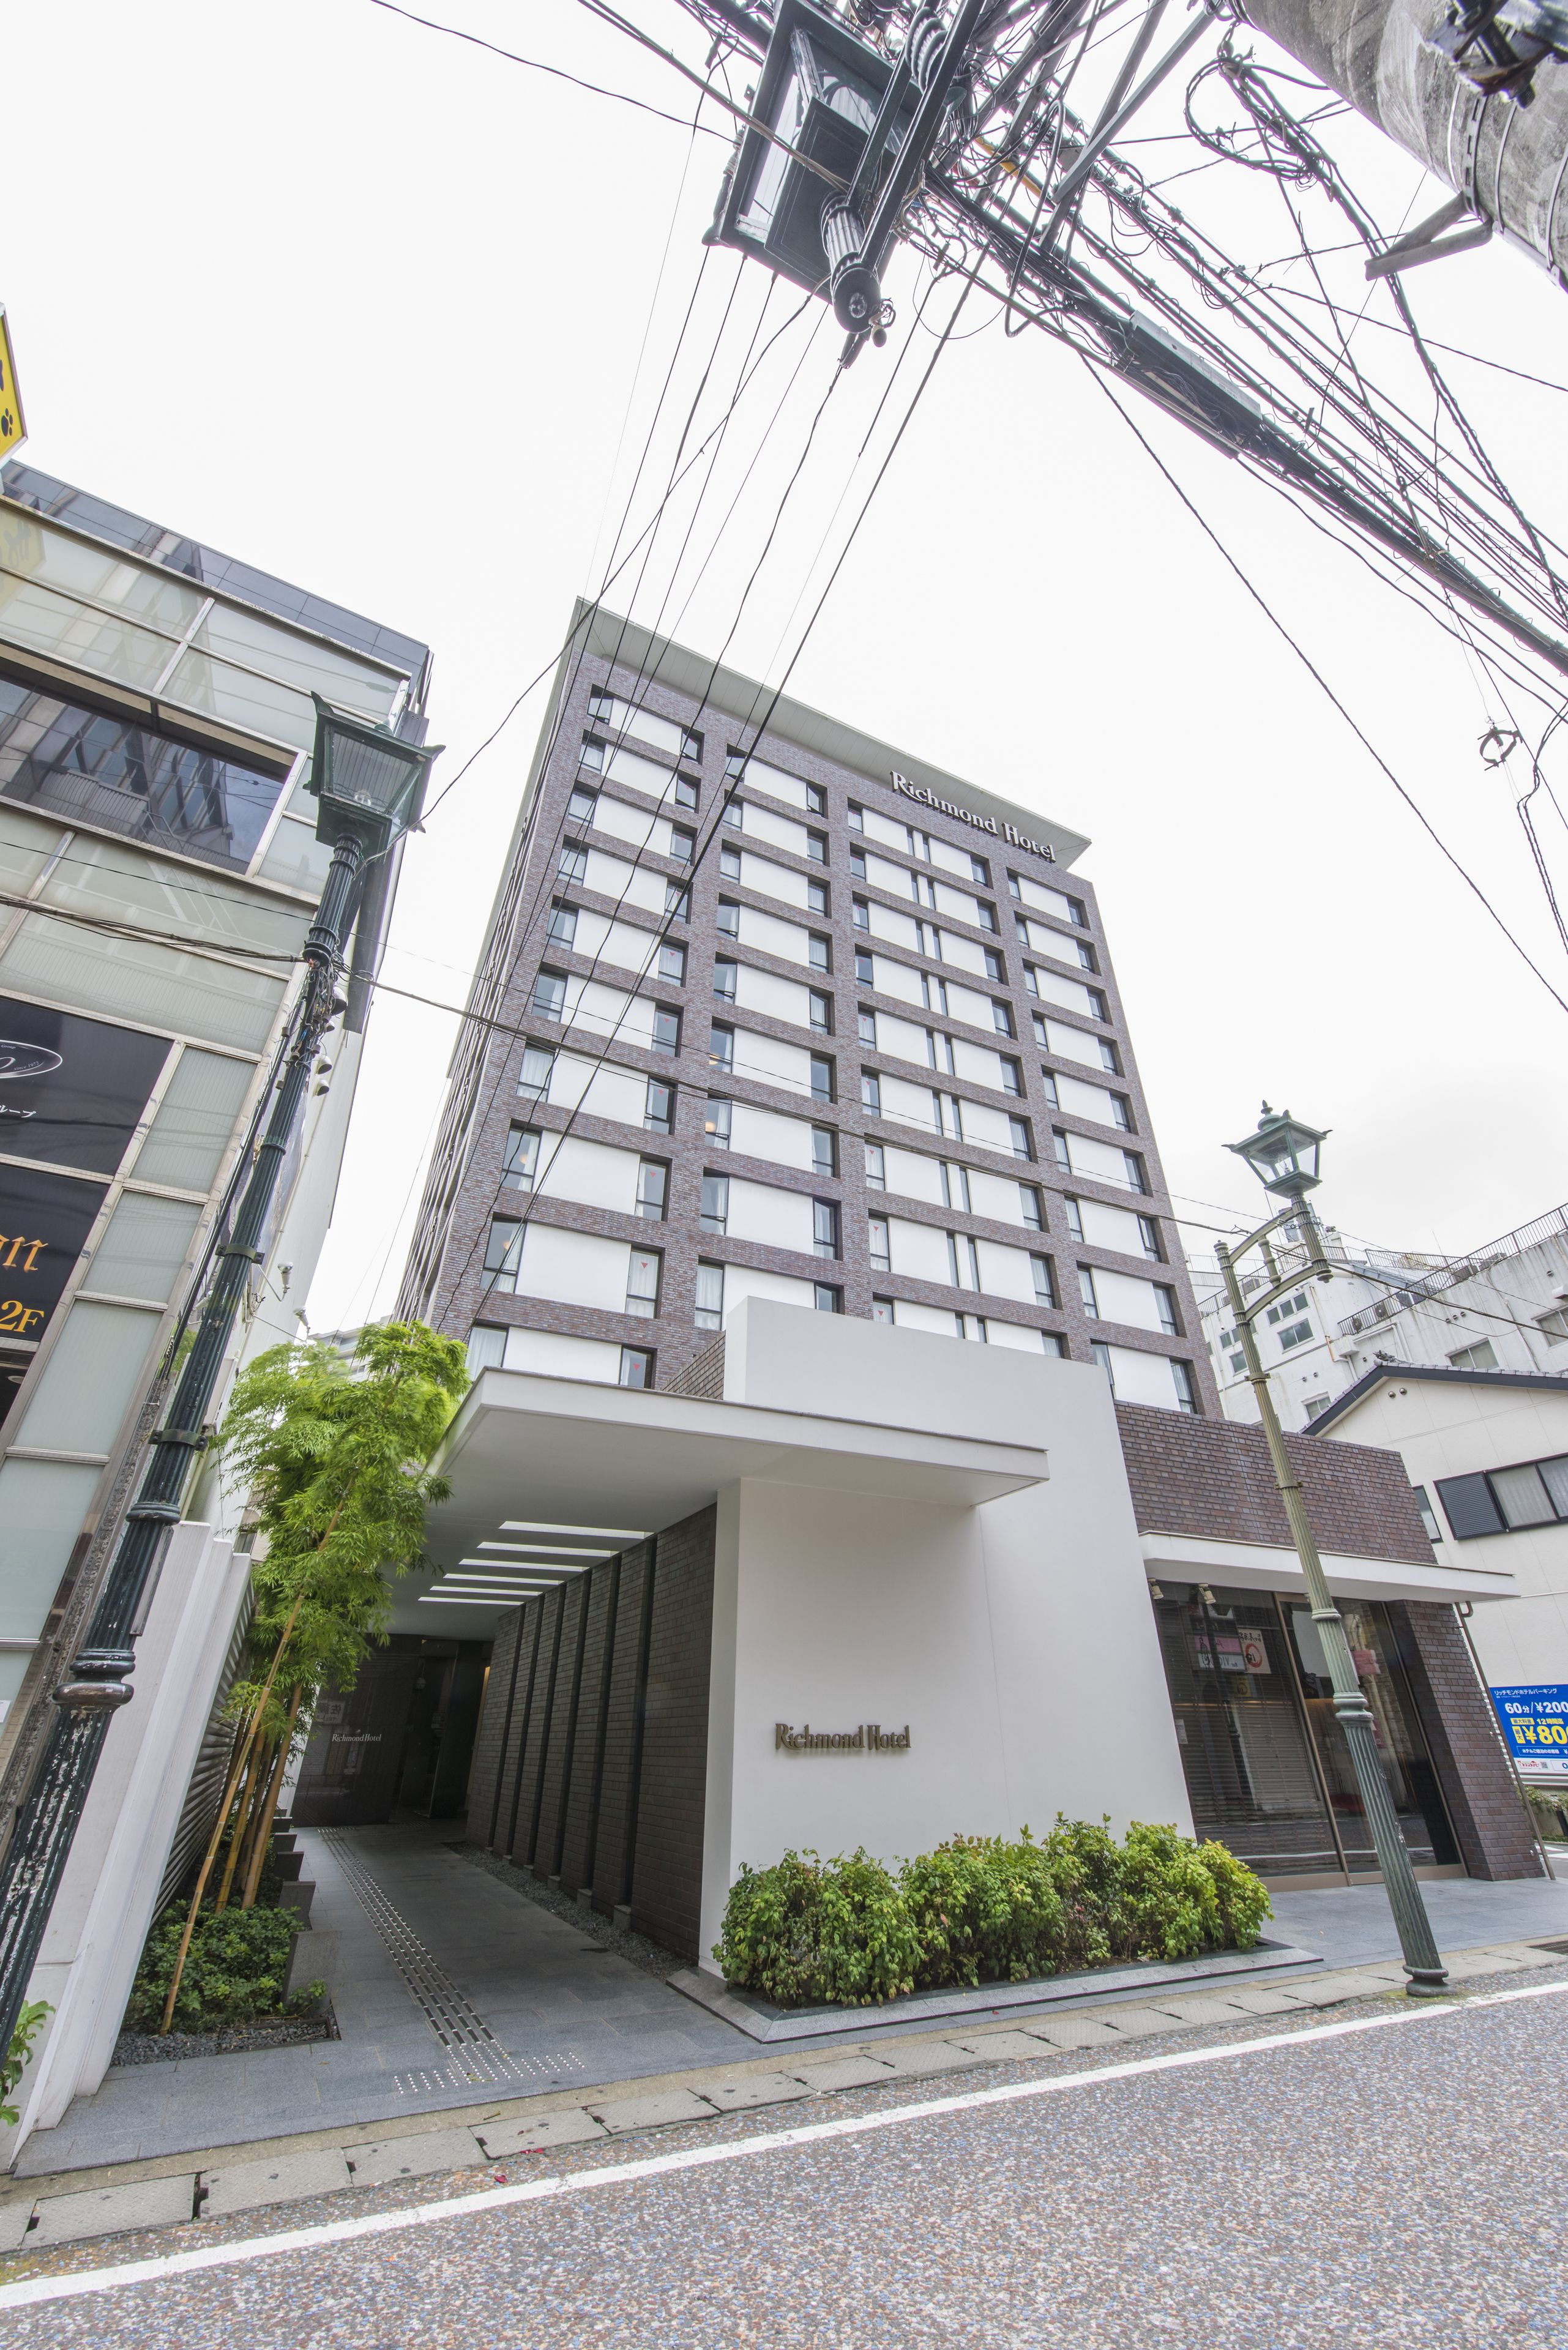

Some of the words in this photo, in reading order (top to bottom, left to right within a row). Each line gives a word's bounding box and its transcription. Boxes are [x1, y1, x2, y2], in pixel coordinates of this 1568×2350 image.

[890, 770, 999, 836] Richmond
[1001, 822, 1056, 863] Hotel
[0, 1300, 45, 1333] 2F
[332, 1734, 364, 1742] Richmond
[364, 1734, 382, 1742] Hotel
[775, 1723, 865, 1751] Richmond
[867, 1725, 911, 1750] Hotel
[1522, 1726, 1568, 1744] ¥80
